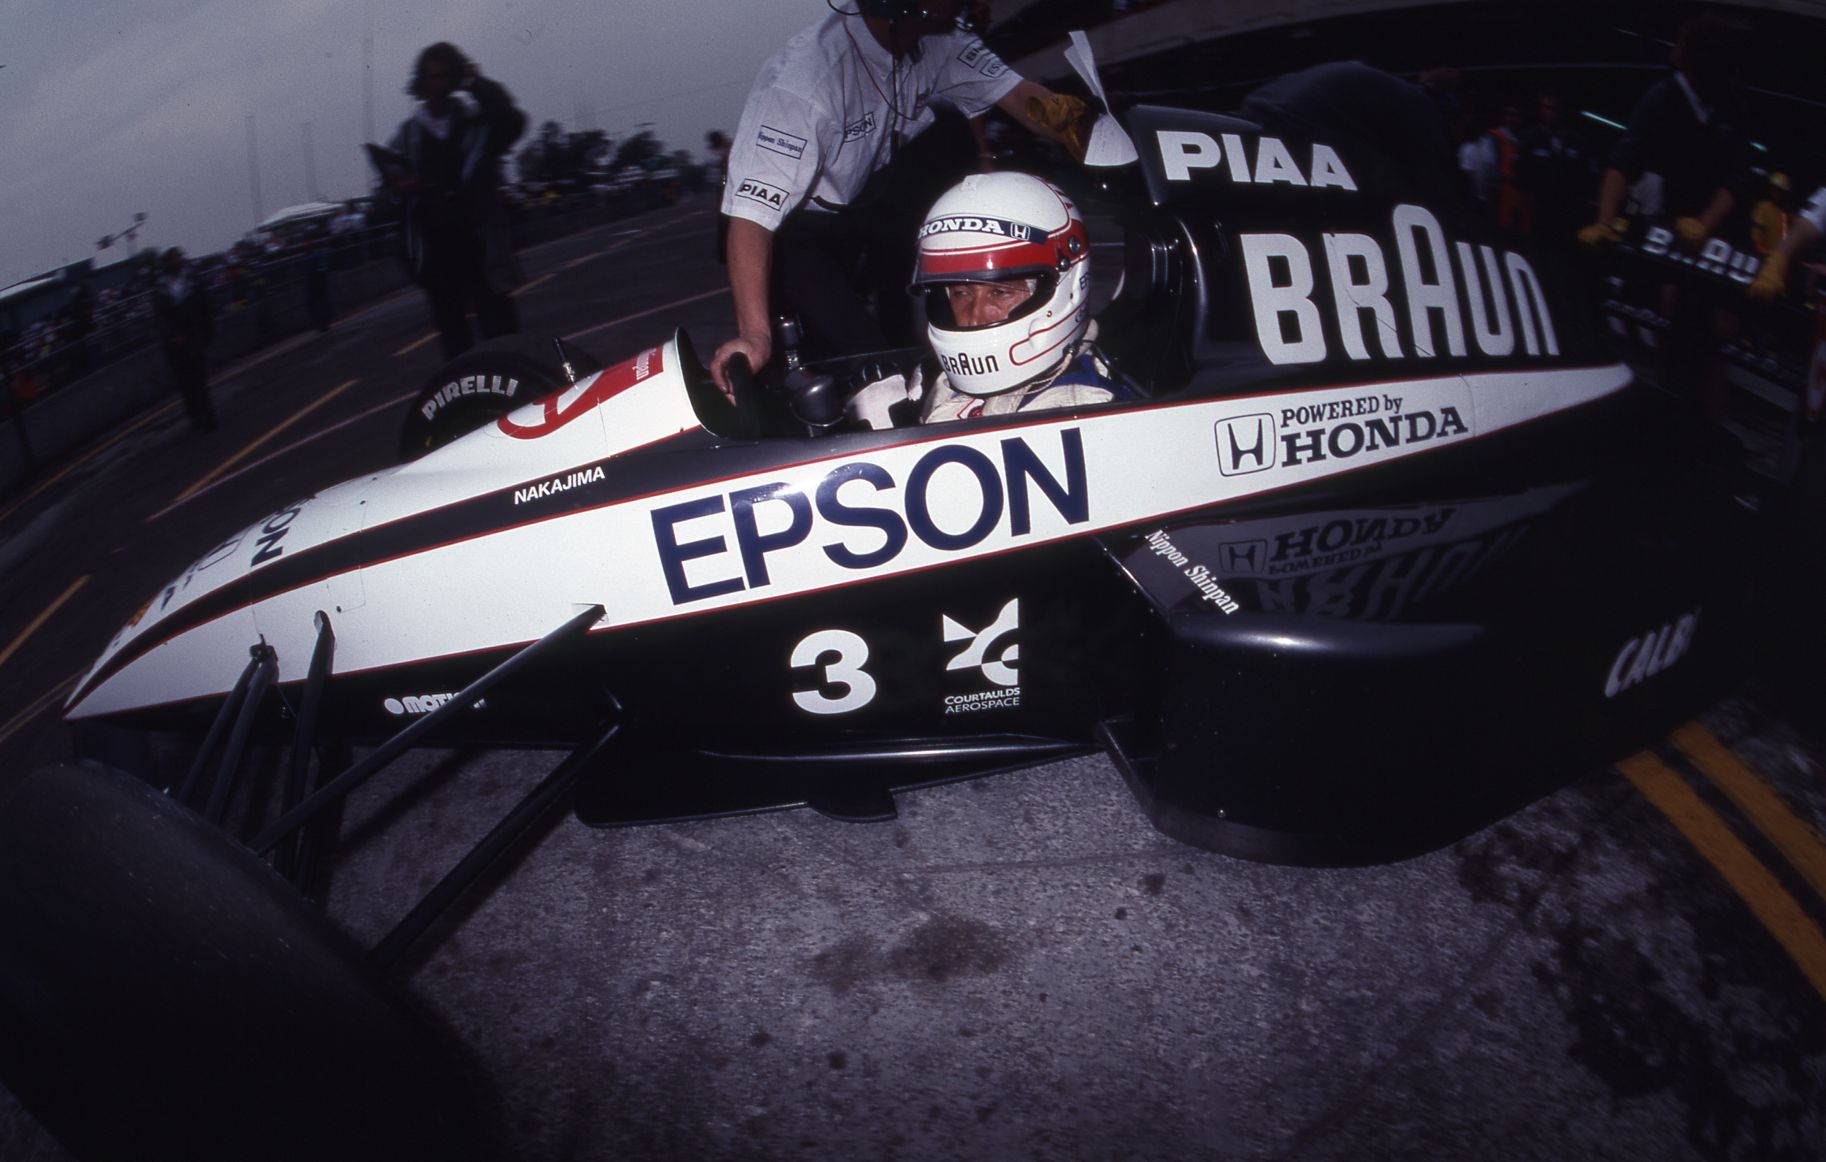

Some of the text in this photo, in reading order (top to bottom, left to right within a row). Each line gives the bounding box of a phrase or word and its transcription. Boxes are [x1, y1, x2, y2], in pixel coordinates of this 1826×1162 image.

[1156, 130, 1358, 191] PIAA
[739, 184, 781, 206] PIAA
[919, 217, 1006, 239] HONDA
[1240, 204, 1561, 366] BRAUN
[941, 352, 999, 376] BRAUN
[421, 375, 519, 421] PIRELLI
[1280, 394, 1403, 428] POWERED by
[1280, 406, 1468, 467] HONDA
[514, 466, 606, 505] NAKAJIMA
[651, 427, 1090, 605] EPSON
[1144, 529, 1189, 568] Nippon
[1183, 564, 1240, 615] Shinpan
[790, 629, 876, 714] 3
[945, 687, 1021, 704] COURTAULDS
[945, 697, 1020, 714] AEROSPACE
